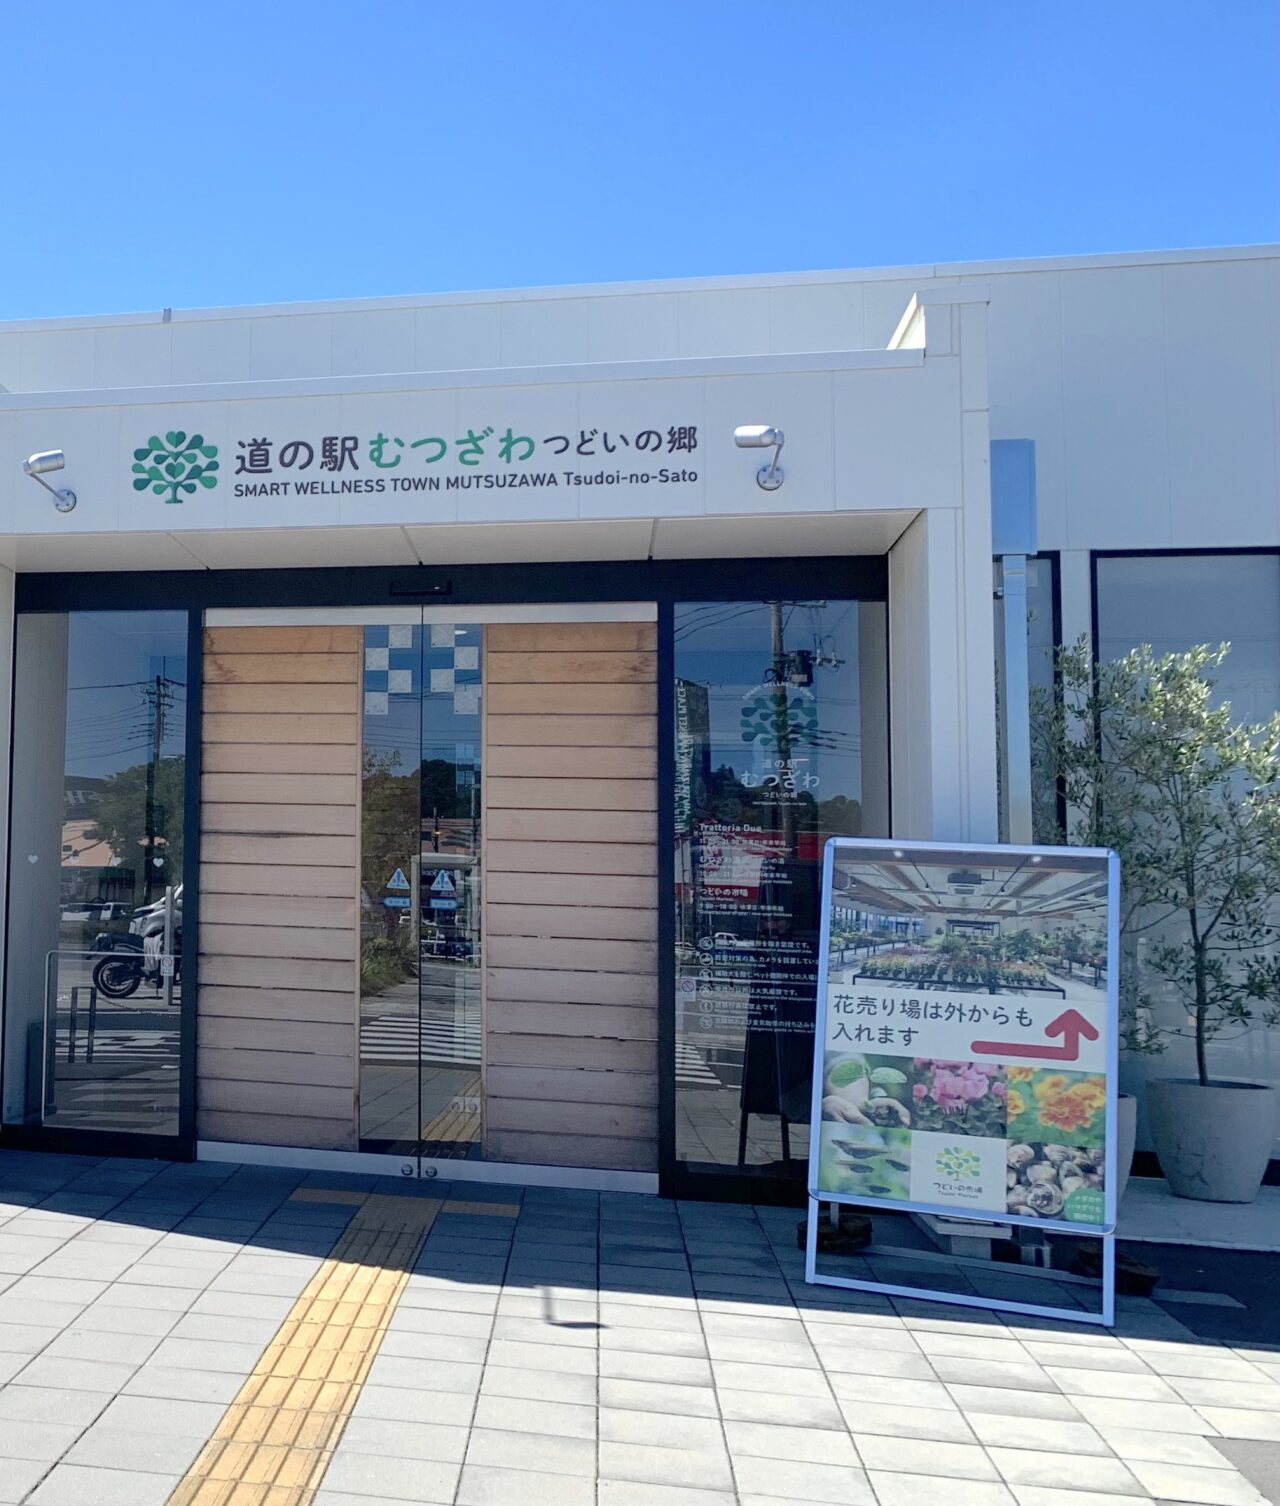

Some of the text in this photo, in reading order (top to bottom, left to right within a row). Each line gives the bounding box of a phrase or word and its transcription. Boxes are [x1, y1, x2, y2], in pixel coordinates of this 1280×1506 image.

[234, 468, 698, 498] SMART WELLNESS TOWN MUTSUZAWA Tsudoi-no-Sato
[740, 770, 820, 788] むつざわ
[699, 824, 741, 832] Trattoria
[834, 994, 1033, 1027] 花売り場は外からも
[832, 1022, 920, 1046] 入れます
